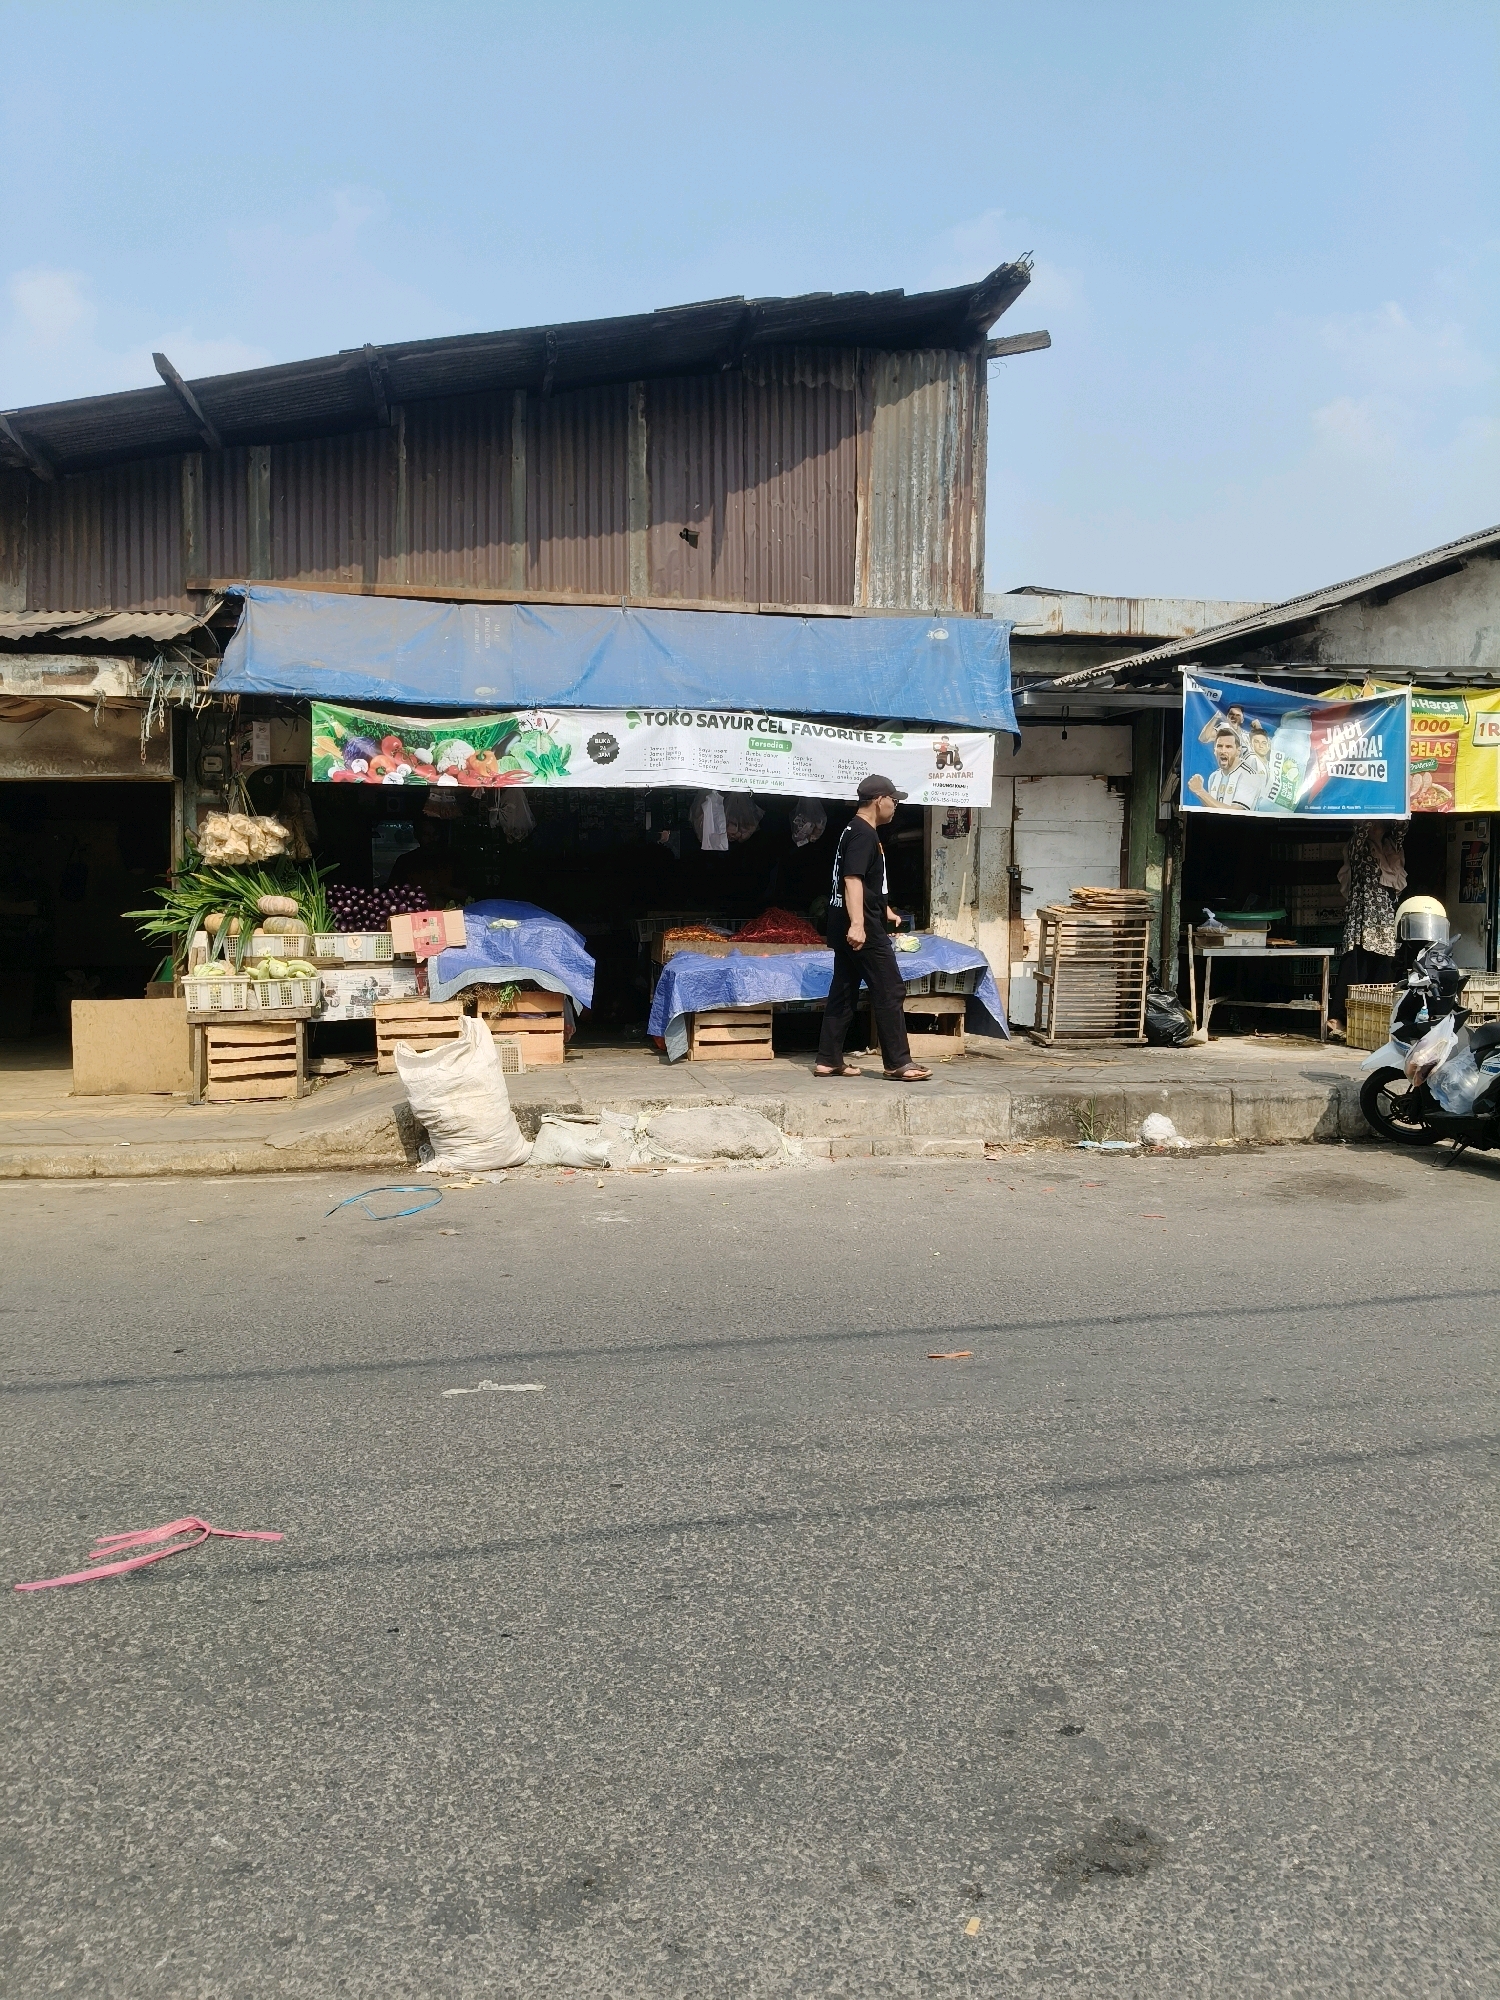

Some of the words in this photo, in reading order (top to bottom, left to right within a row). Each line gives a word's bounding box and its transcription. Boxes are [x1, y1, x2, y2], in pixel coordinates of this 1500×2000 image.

[1420, 699, 1459, 712] Harga
[644, 711, 693, 727] TOKO
[696, 713, 753, 731] SAYUR
[757, 718, 788, 735] CEL
[791, 722, 874, 743] FAVORITE
[876, 733, 887, 744] 2
[1321, 719, 1363, 745] JADI
[1479, 722, 1486, 737] 1
[750, 739, 784, 750] Tersedia
[1325, 734, 1383, 761] JUARA!
[1410, 740, 1452, 757] GELAS
[928, 772, 945, 780] SIAP
[946, 771, 974, 779] ANTAR!
[1328, 763, 1386, 779] mizone
